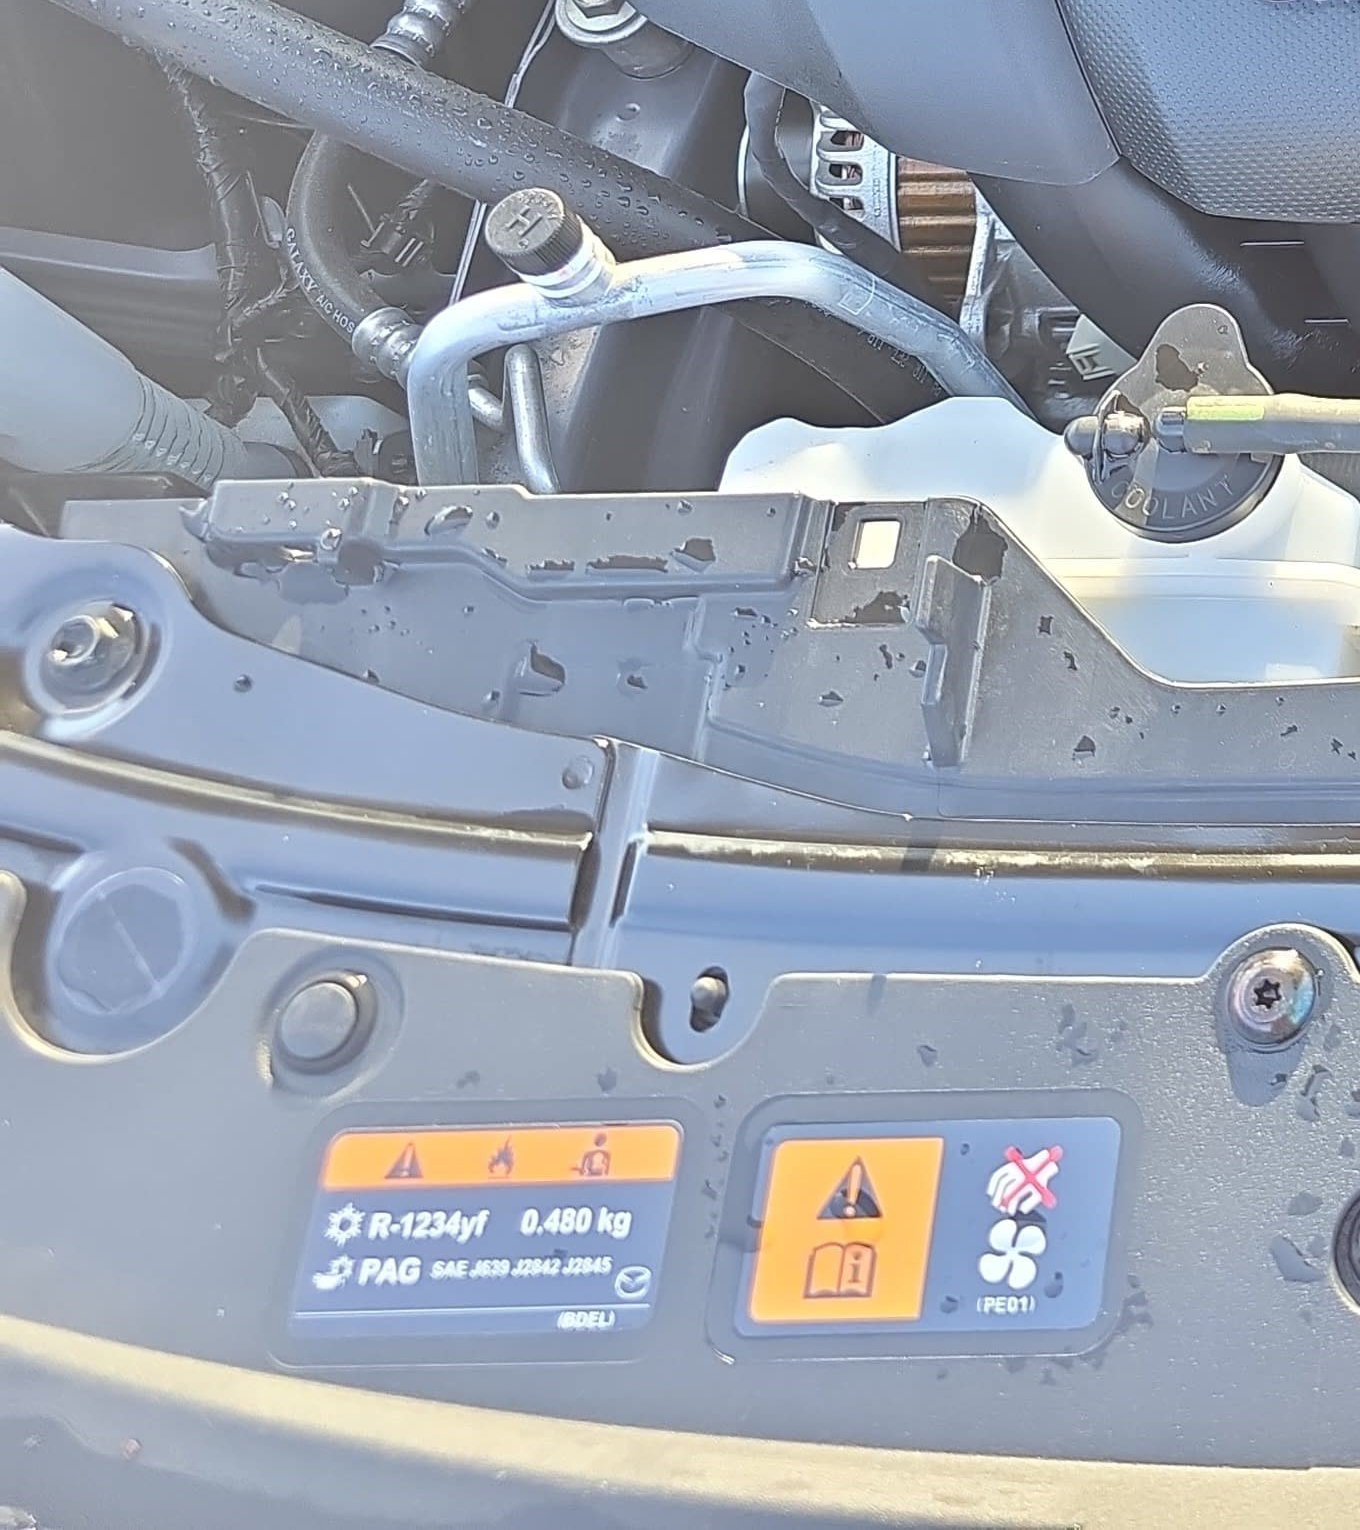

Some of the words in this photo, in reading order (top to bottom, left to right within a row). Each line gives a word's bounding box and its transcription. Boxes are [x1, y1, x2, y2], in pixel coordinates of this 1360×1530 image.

[332, 309, 356, 334] HOS
[1111, 474, 1233, 520] COOLANT
[367, 1210, 490, 1244] R-1234yf
[520, 1208, 591, 1237] 0.480
[595, 1207, 632, 1239] kg
[358, 1256, 421, 1286] PAG
[430, 1258, 468, 1280] SAE
[976, 1295, 1036, 1315] (PE01)
